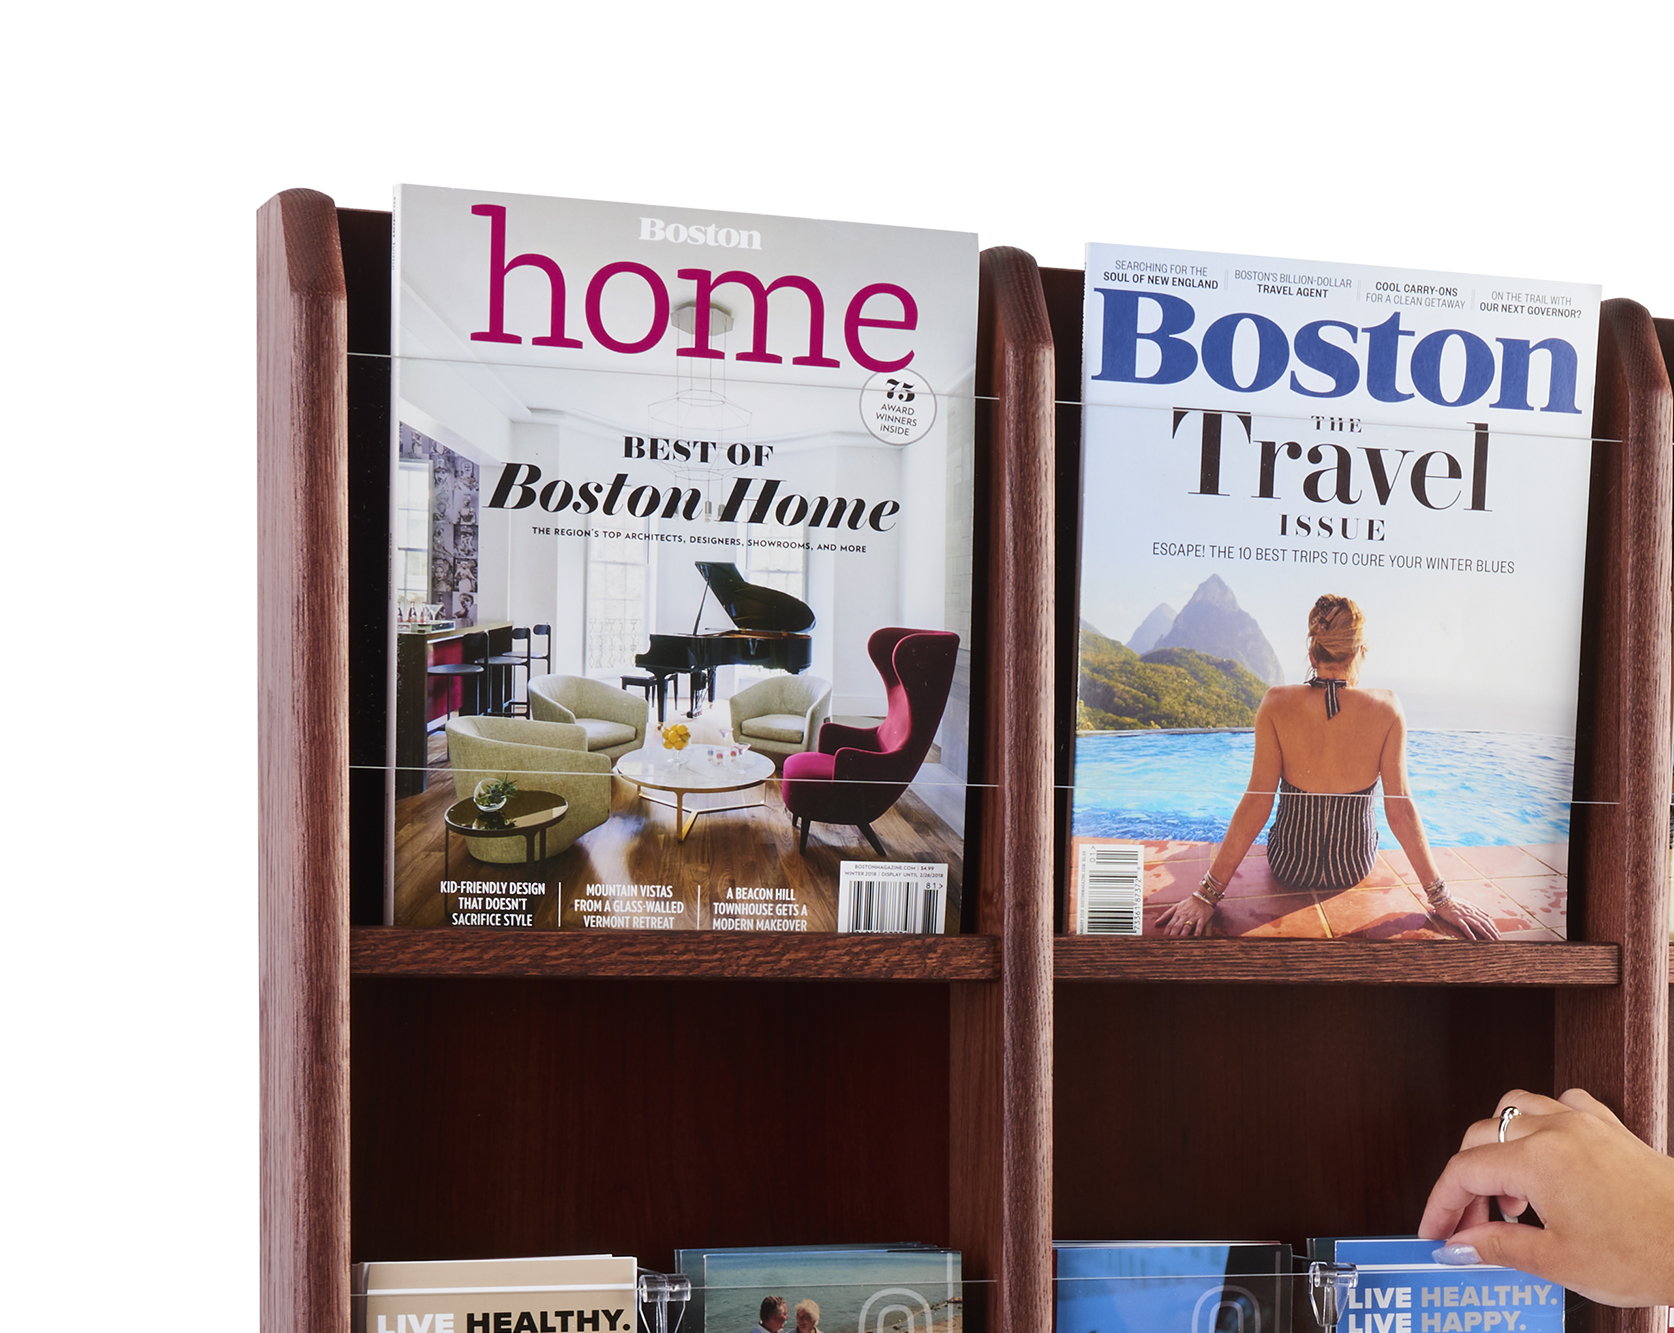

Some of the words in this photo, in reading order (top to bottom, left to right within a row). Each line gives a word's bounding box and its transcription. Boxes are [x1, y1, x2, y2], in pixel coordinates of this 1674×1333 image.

[639, 217, 762, 250] Boston
[470, 204, 918, 373] home
[1103, 272, 1130, 281] SOUL
[1133, 274, 1145, 283] OF
[1147, 275, 1170, 286] NEW
[1171, 277, 1218, 289] ENGLAND
[1257, 284, 1294, 295] TRAVEL
[1296, 287, 1328, 298] AGENT
[1376, 282, 1400, 292] COOL
[1404, 284, 1458, 296] CARRY-ONS
[1480, 302, 1498, 312] OUR
[1501, 304, 1525, 314] NEXT
[1527, 306, 1582, 319] GOVERNOR?
[1091, 288, 1582, 415] Boston
[886, 379, 915, 402] 75
[876, 412, 917, 426] WINNERS
[881, 404, 914, 415] AWARD
[1311, 415, 1362, 433] THE
[622, 436, 716, 464] BEST
[727, 442, 774, 467] OF
[1172, 407, 1492, 512] Travel
[482, 462, 705, 520] Boston
[714, 477, 900, 532] Home
[1279, 514, 1386, 541] ISSUE
[532, 527, 550, 535] THE
[554, 529, 599, 538] REGION'S
[602, 531, 622, 539] TOP
[625, 532, 686, 543] ARCHITECTS,
[690, 536, 744, 547] DESIGNERS,
[747, 539, 813, 550] SHOWROOMS,
[817, 543, 837, 551] AND
[1152, 542, 1205, 558] ESCAPE!
[1210, 546, 1234, 559] THE
[1238, 547, 1251, 560] 10
[1256, 548, 1288, 562] BEST
[1292, 550, 1328, 564] TRIPS
[1332, 552, 1348, 565] TO
[1352, 553, 1385, 567] CURE
[1389, 555, 1422, 569] YOUR
[1426, 557, 1472, 572] WINTER
[1477, 560, 1514, 573] BLUES
[440, 881, 507, 895] KID-FRIENDLY
[510, 883, 545, 895] DESIGN
[459, 898, 483, 909] THAT
[486, 898, 526, 910] DOESN'T
[452, 913, 501, 926] SACRIFICE
[504, 915, 533, 926] STYLE
[1348, 1287, 1412, 1309] LIVE
[1421, 1285, 1558, 1308] HEALTHY.
[1421, 1311, 1526, 1333] HAPPY.
